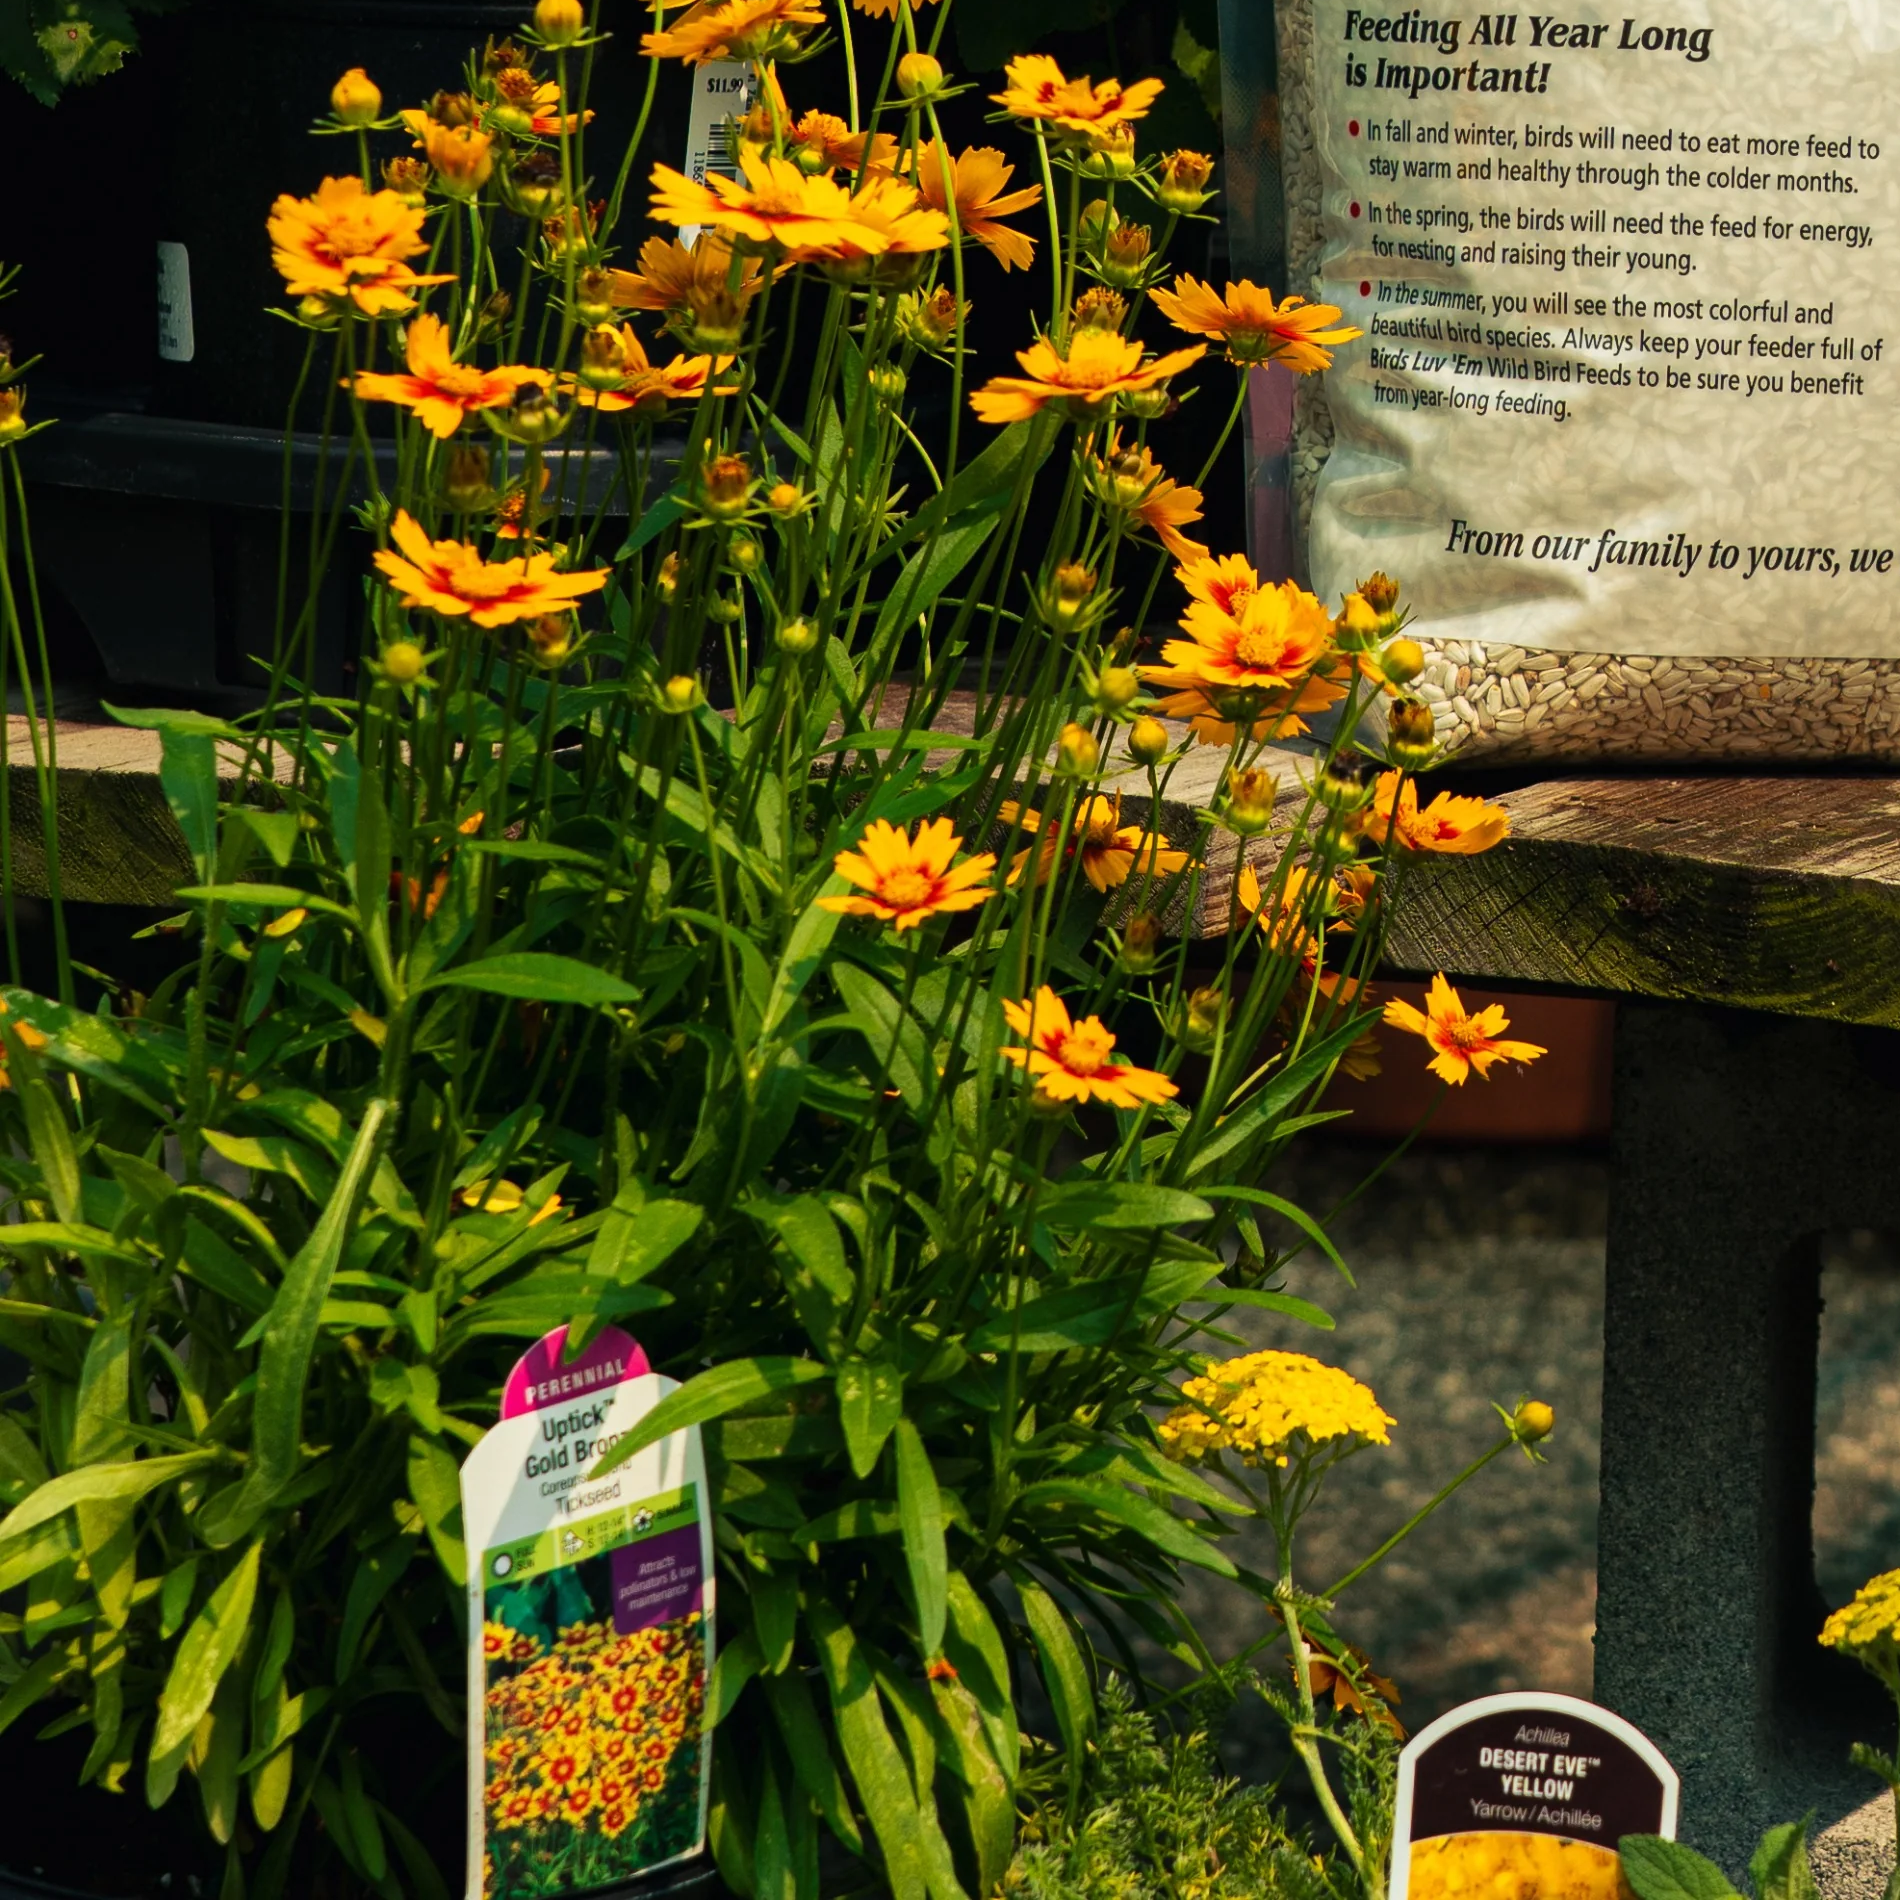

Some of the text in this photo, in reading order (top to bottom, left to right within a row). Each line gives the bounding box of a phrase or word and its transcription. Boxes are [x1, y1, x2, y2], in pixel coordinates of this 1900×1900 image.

[1344, 8, 1714, 63] Feeding All Year Long
[706, 77, 744, 93] $11.99
[1345, 52, 1552, 99] is Important!
[1368, 201, 1873, 248] In the spring, the birds will need the feed for energy,
[1371, 235, 1697, 276] for nesting and raising their young.
[1445, 518, 1525, 559] From
[1530, 532, 1590, 563] our
[1589, 528, 1703, 579] family
[1707, 538, 1739, 571] to
[1743, 545, 1843, 580] yours,
[1849, 550, 1894, 573] we
[524, 1358, 626, 1406] PERENNIAL
[525, 1444, 569, 1479] Gold
[556, 1480, 621, 1515] Tickseed
[619, 1565, 697, 1600] pollinators & low
[638, 1555, 676, 1576] Attracts
[628, 1582, 689, 1611] maintenance
[1513, 1724, 1571, 1749] Achillea
[1479, 1747, 1550, 1773] DESERT
[1500, 1774, 1574, 1801] YELLOW
[1470, 1798, 1527, 1822] Yarrow
